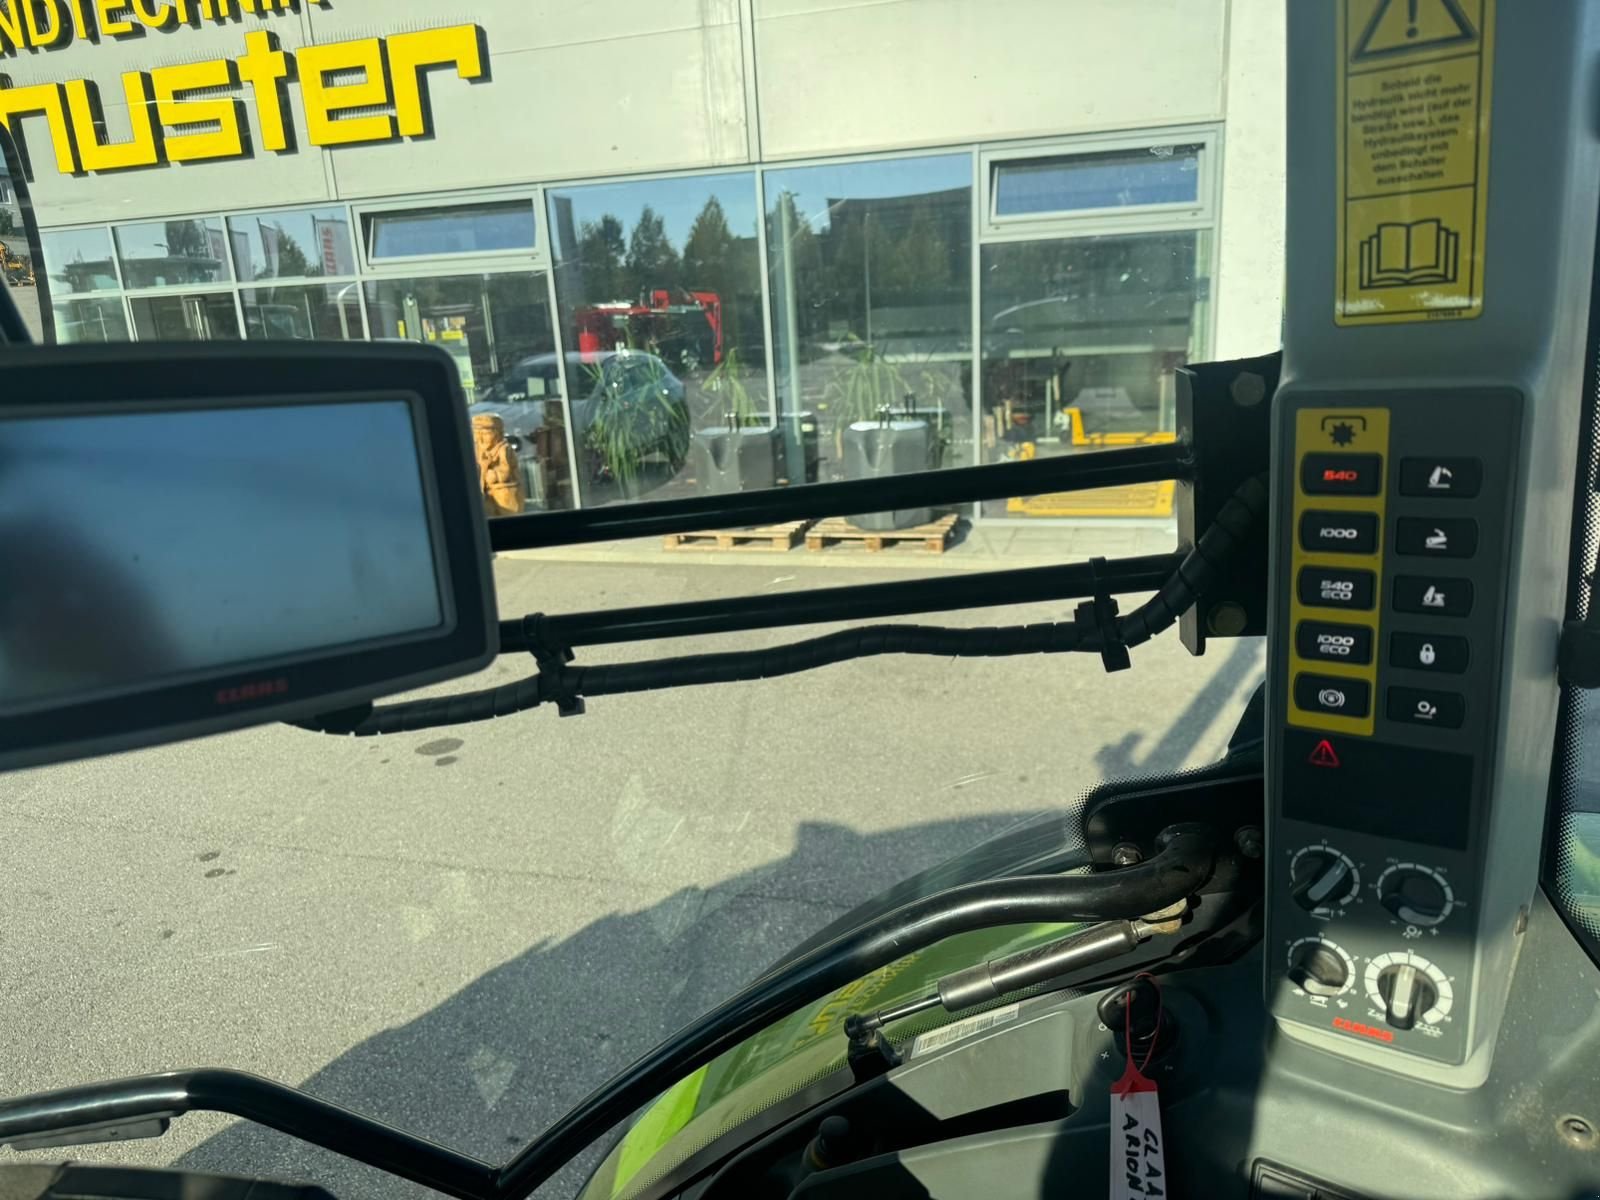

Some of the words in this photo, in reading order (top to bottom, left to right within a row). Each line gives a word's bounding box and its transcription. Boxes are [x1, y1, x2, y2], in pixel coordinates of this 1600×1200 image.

[1323, 469, 1358, 482] 540
[1320, 527, 1358, 539] 1000
[1320, 579, 1354, 592] 540
[1321, 590, 1352, 601] ECO
[1317, 633, 1355, 647] 1000
[1320, 644, 1350, 656] ECO
[1122, 1112, 1145, 1193] ARION
